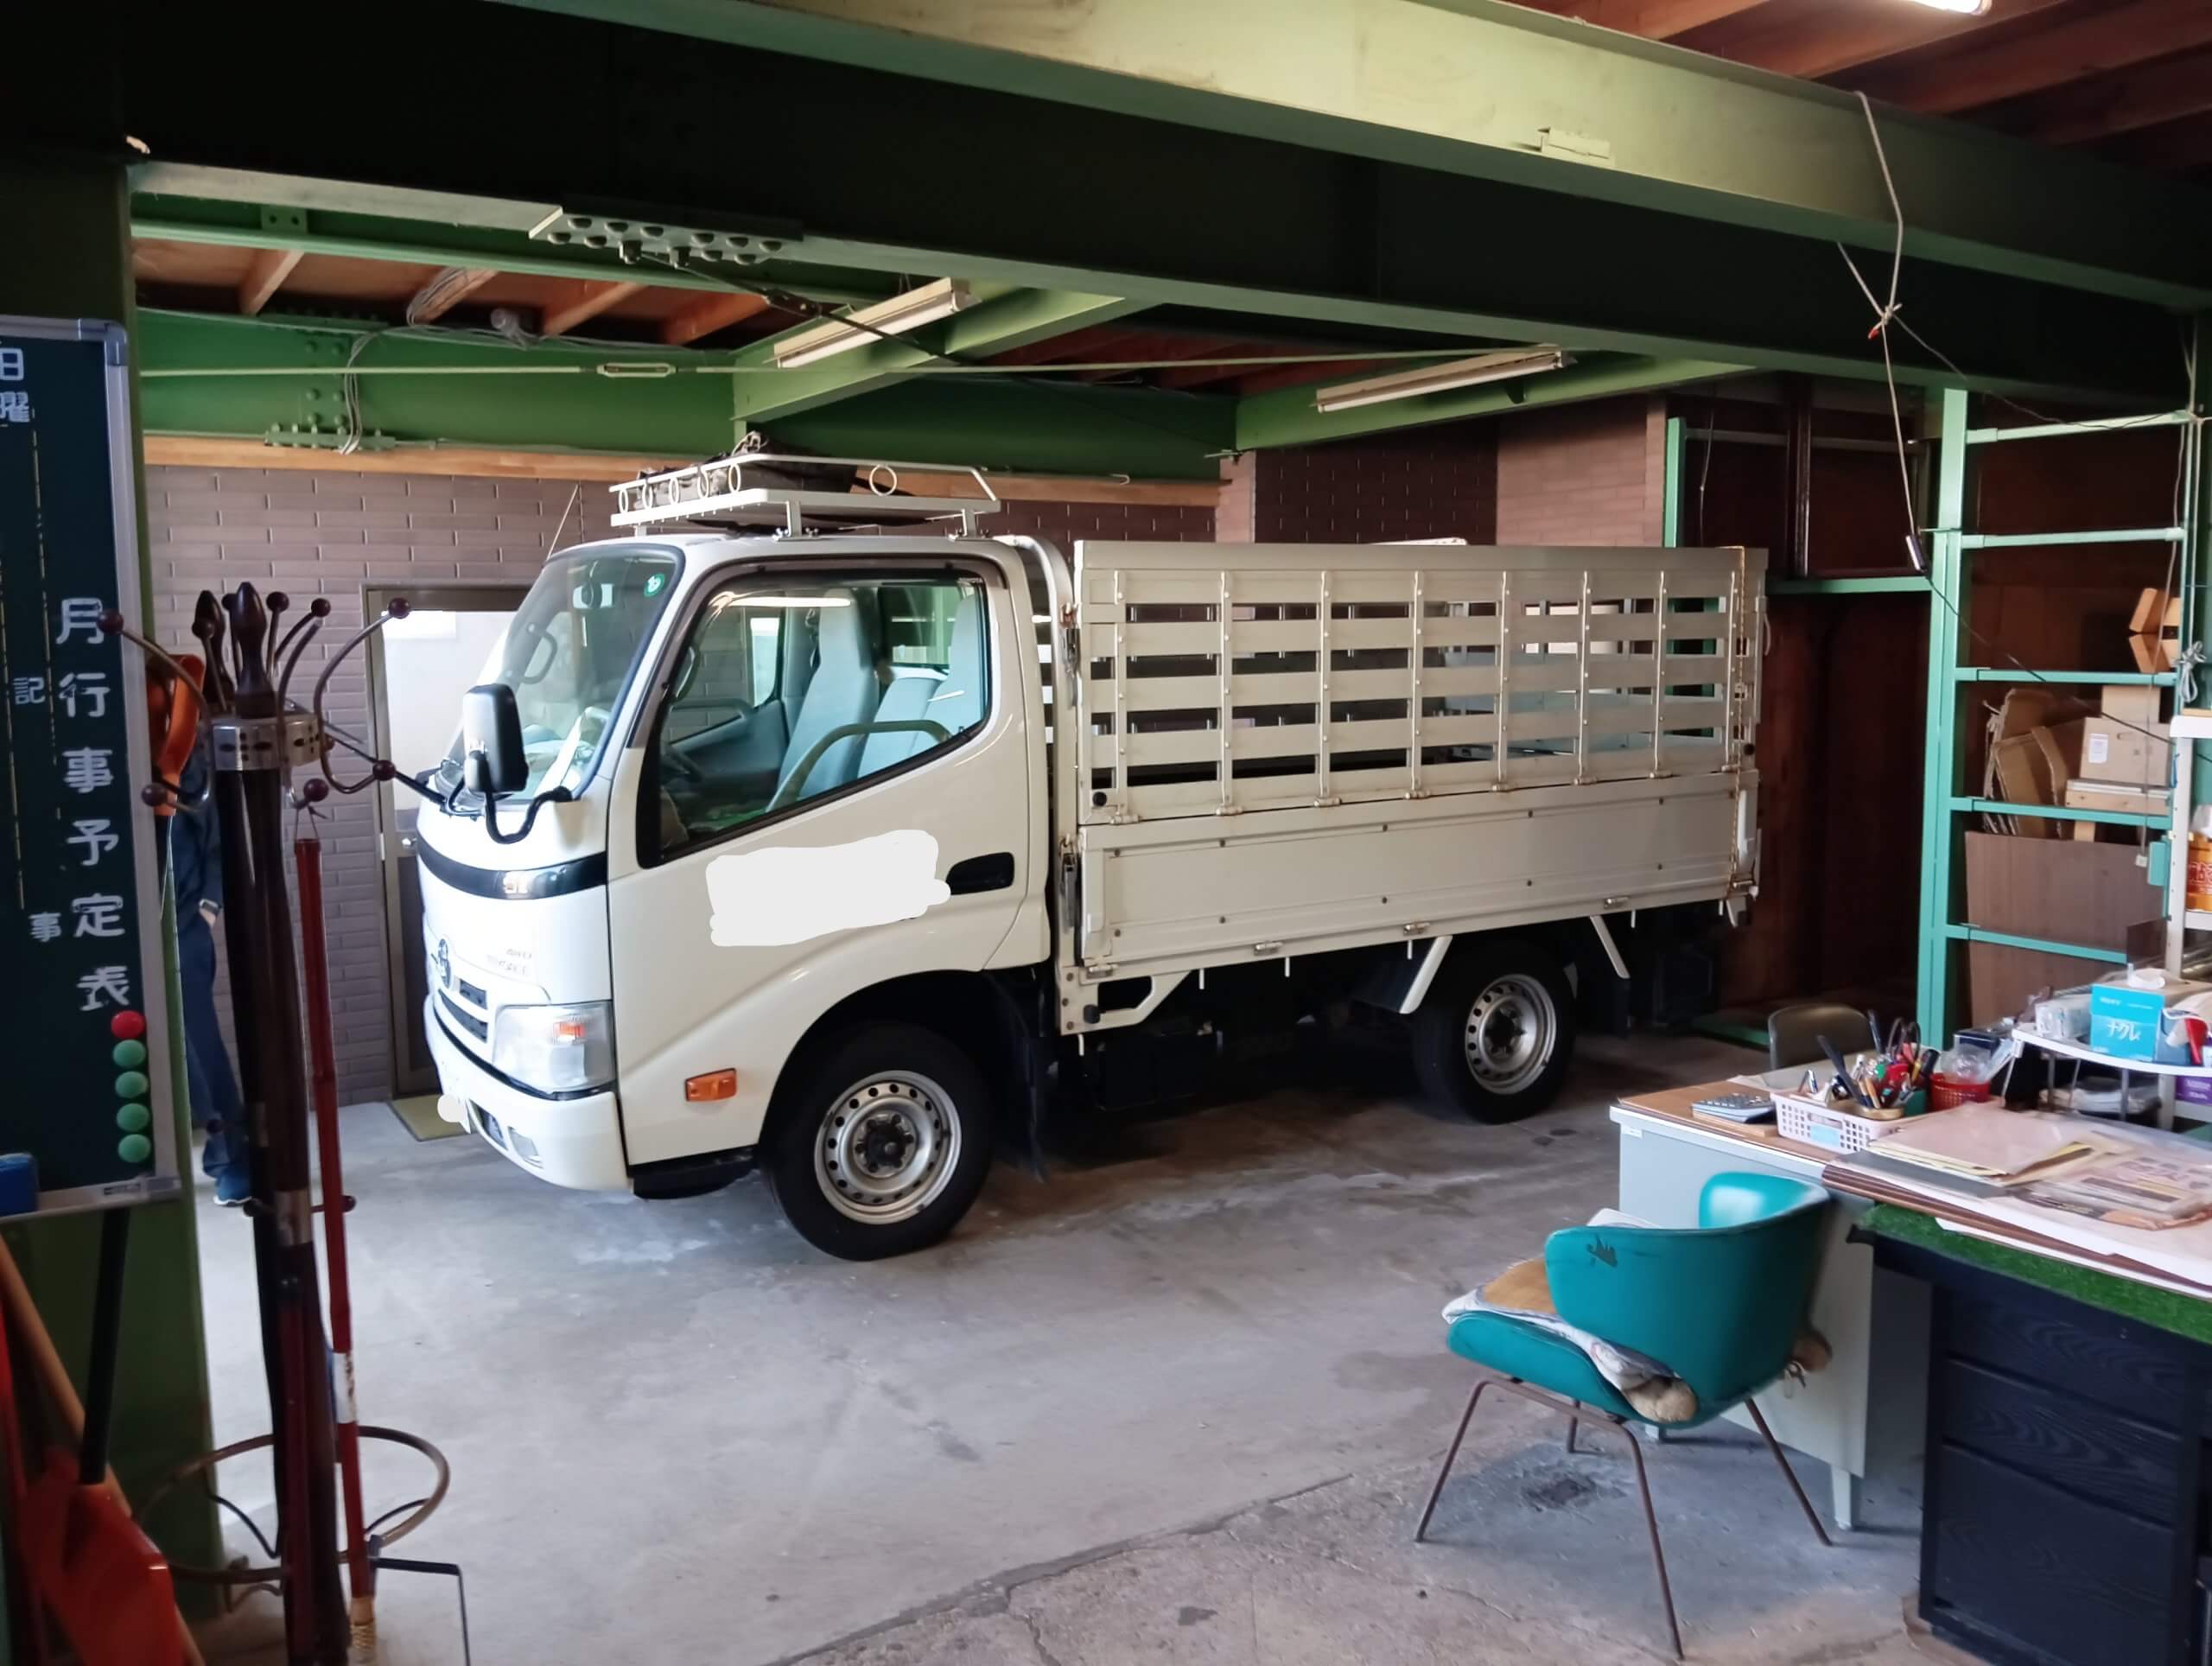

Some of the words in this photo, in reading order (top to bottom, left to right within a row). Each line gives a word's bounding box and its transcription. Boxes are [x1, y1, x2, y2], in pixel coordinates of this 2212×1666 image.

[55, 597, 130, 1011] 月行事予定表
